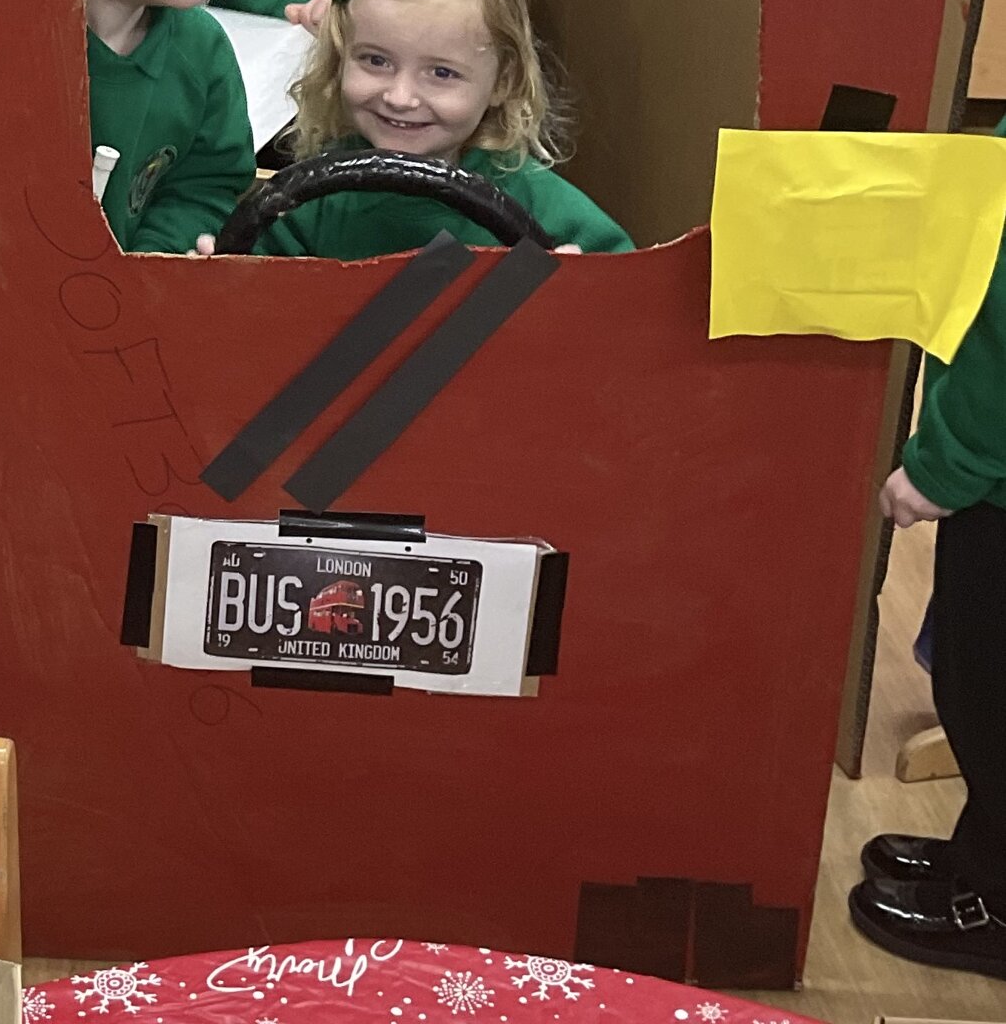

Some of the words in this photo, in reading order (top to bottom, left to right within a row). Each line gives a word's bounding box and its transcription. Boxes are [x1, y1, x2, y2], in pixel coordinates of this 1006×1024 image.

[316, 557, 372, 577] LONDON
[449, 570, 469, 586] 50
[217, 571, 304, 637] BUS
[370, 582, 465, 649] 1956
[217, 633, 231, 647] 19
[278, 639, 331, 657] UNITED
[338, 641, 401, 661] KINGDOM
